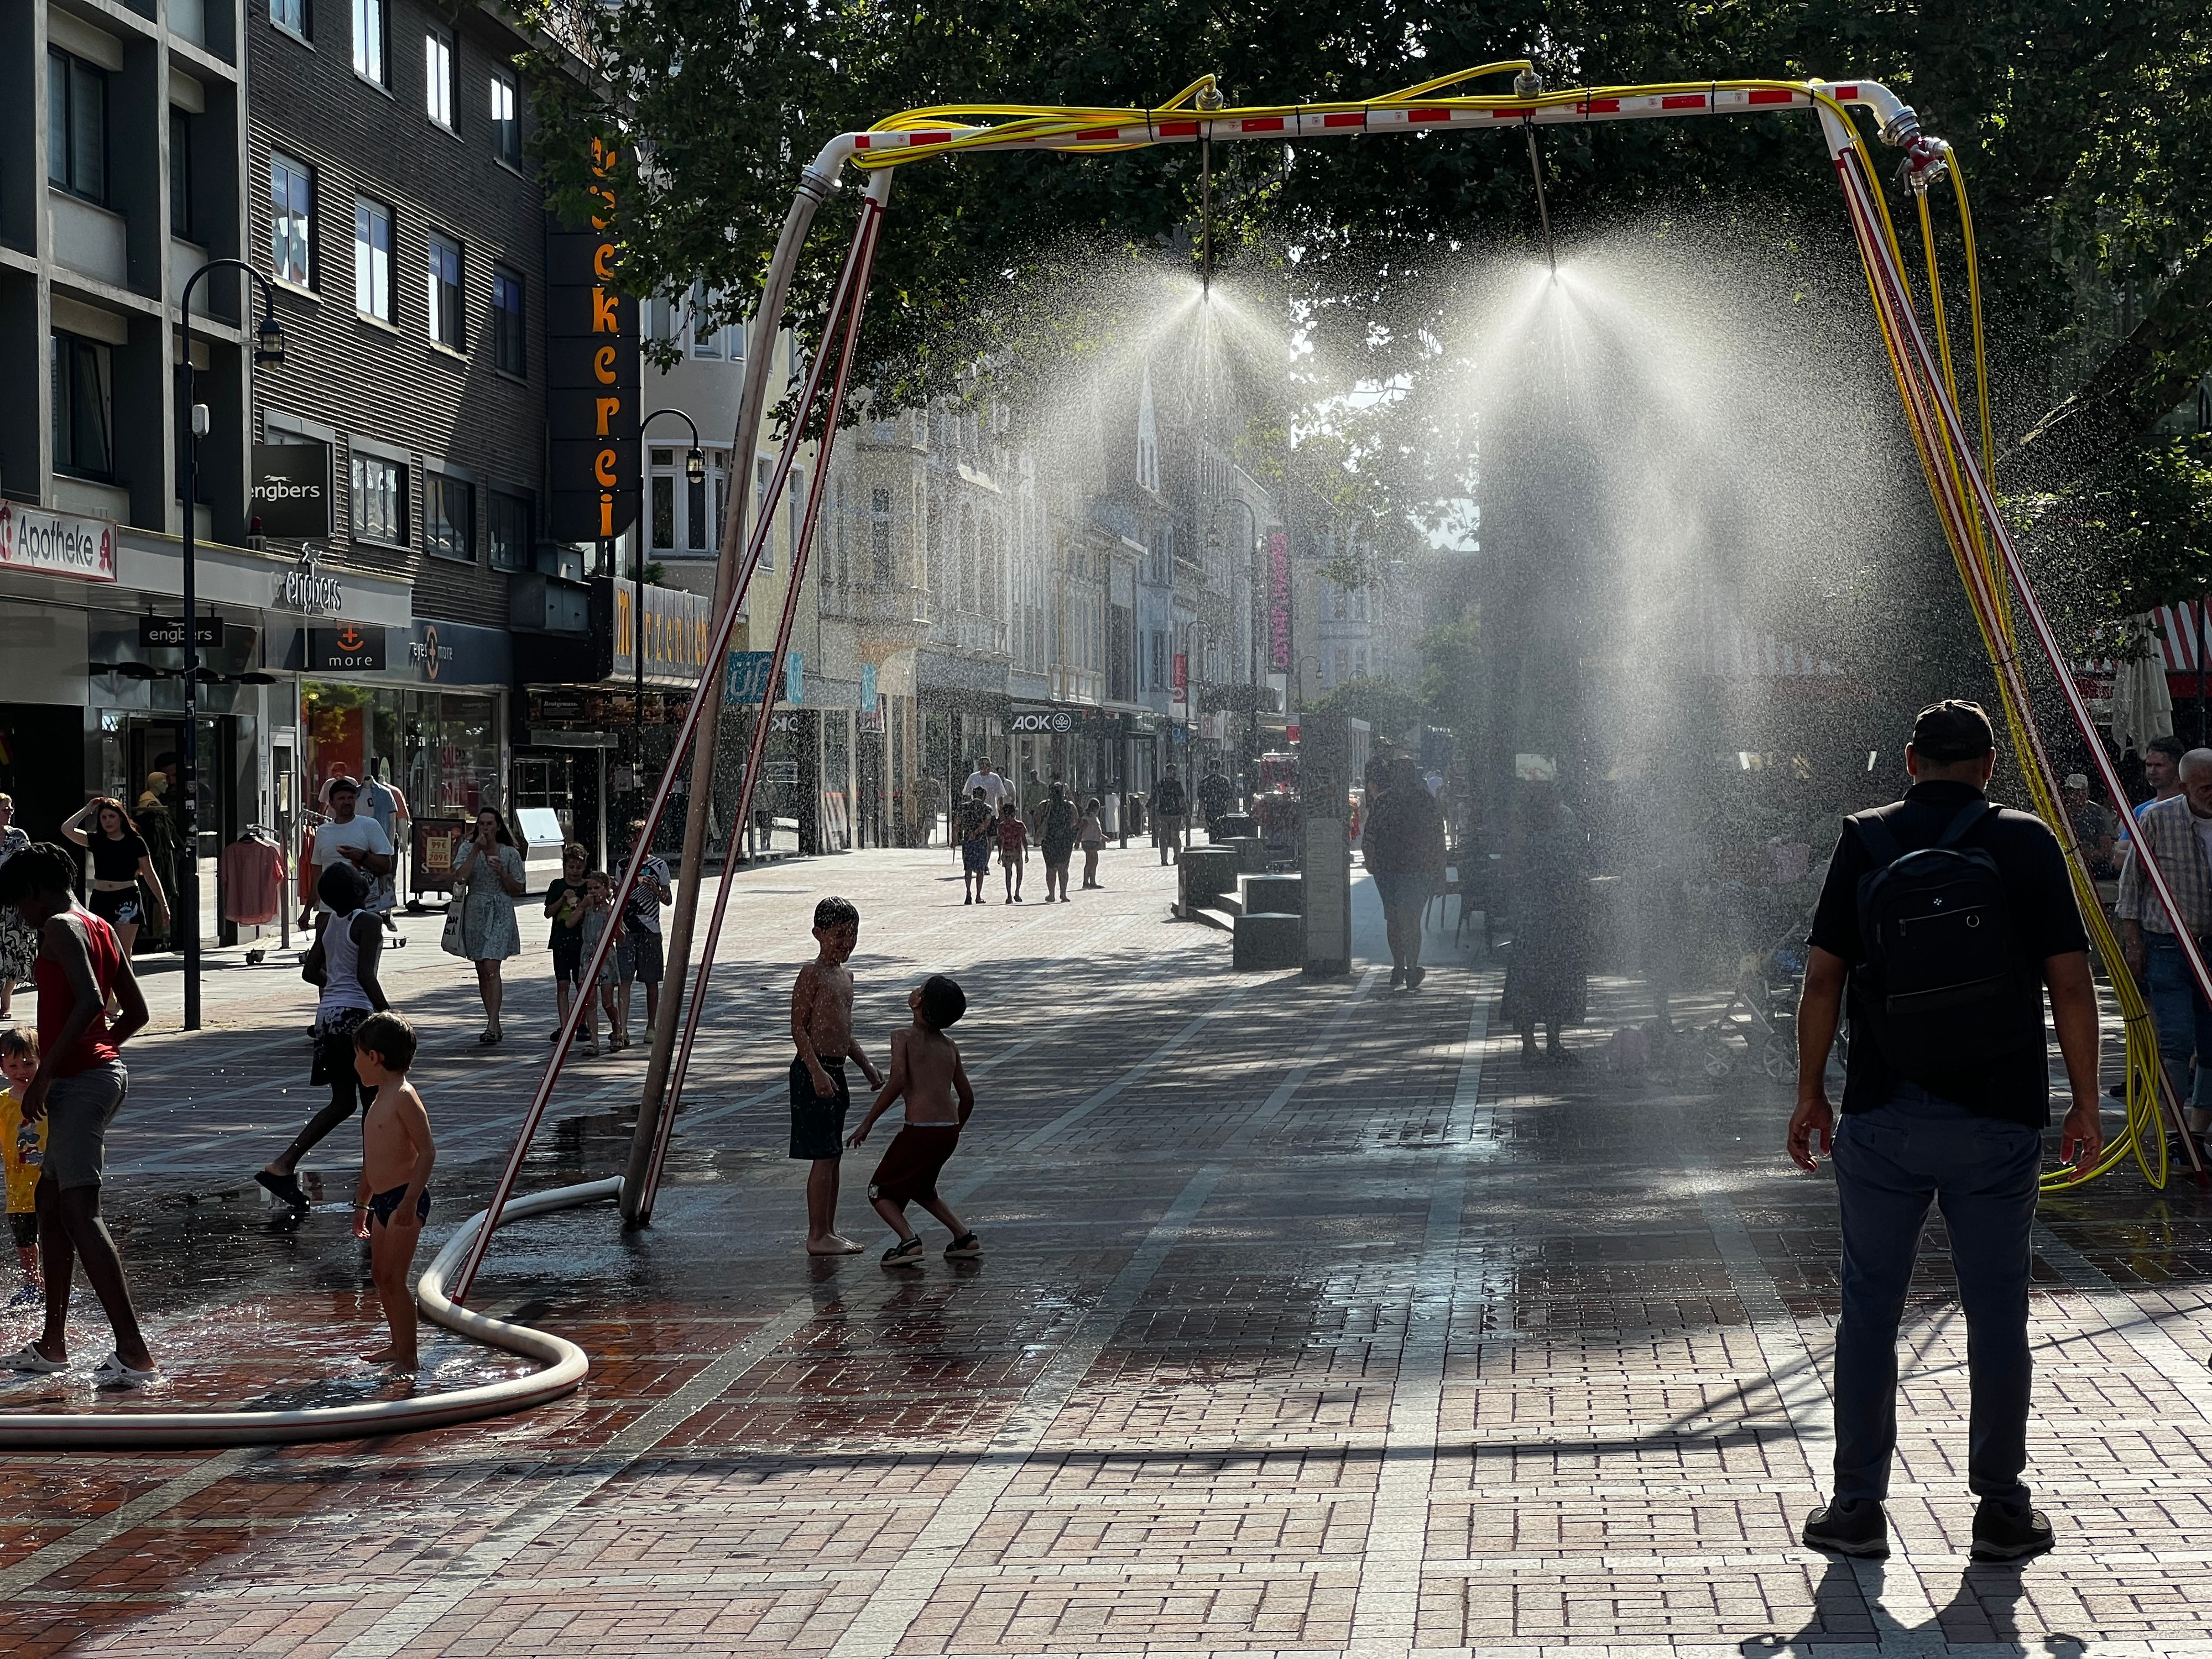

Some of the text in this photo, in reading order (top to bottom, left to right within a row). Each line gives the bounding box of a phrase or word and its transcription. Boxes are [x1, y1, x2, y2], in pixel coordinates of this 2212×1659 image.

[251, 482, 320, 502] ngbers
[18, 515, 93, 566] Apotheke
[286, 568, 341, 615] engbers
[149, 627, 212, 643] engbrs
[329, 656, 373, 666] more
[1011, 715, 1051, 731] AOK
